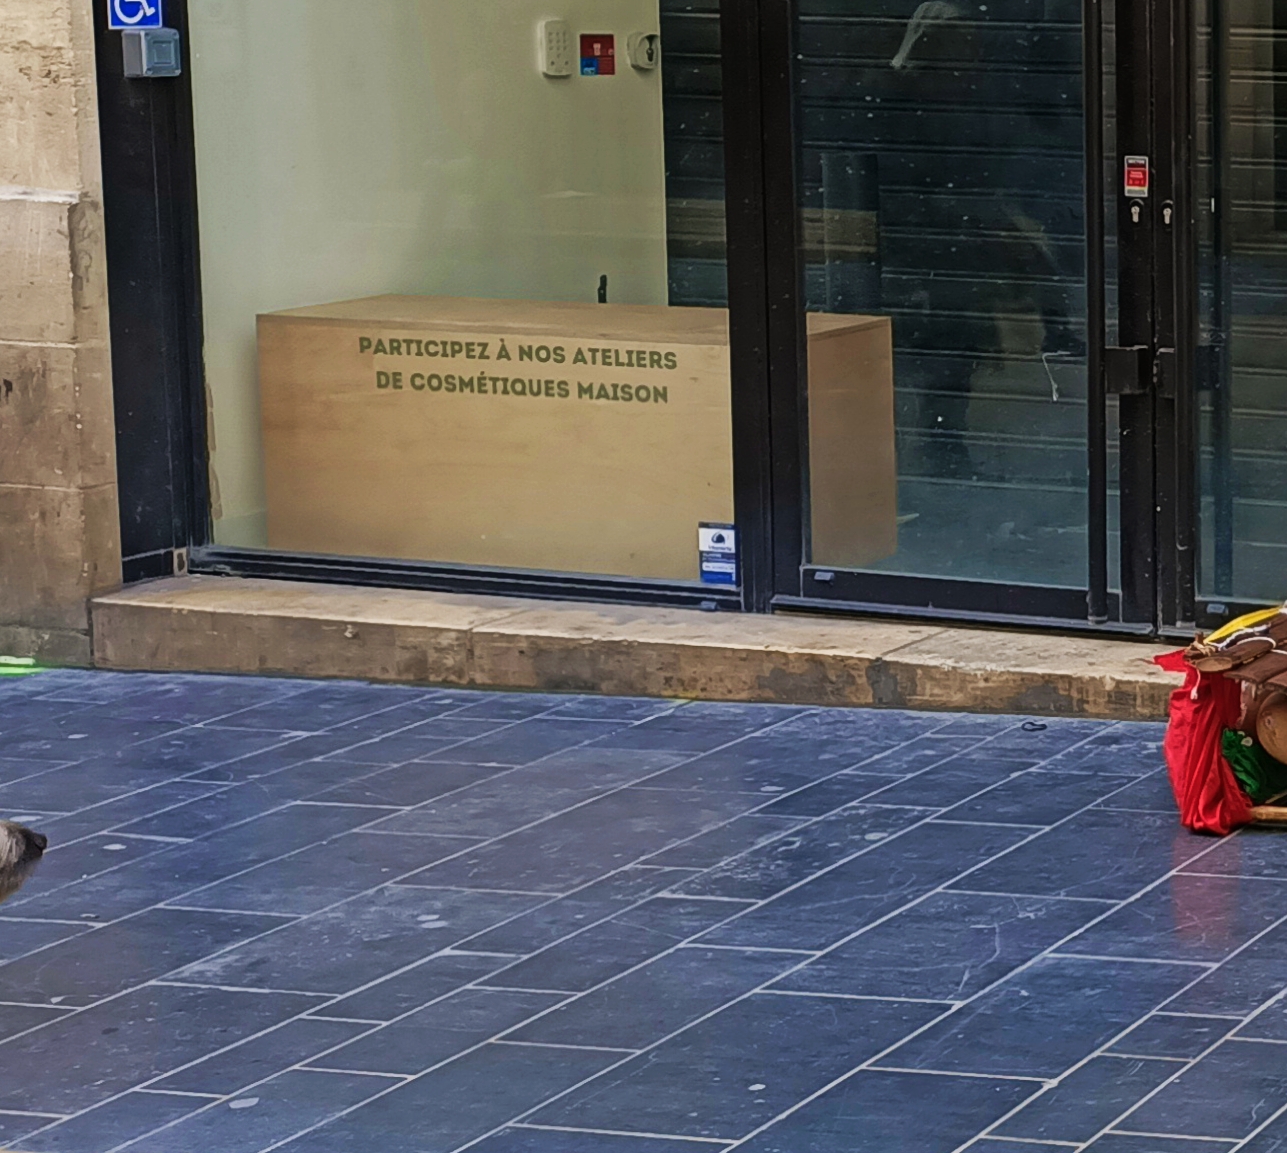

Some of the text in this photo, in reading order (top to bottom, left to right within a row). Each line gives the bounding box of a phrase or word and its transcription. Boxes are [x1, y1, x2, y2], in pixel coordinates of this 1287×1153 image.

[359, 336, 677, 370] PARTICIPEZ À NOS ATELIERS
[376, 370, 668, 404] DE COSMÉTIQUES MAISON
